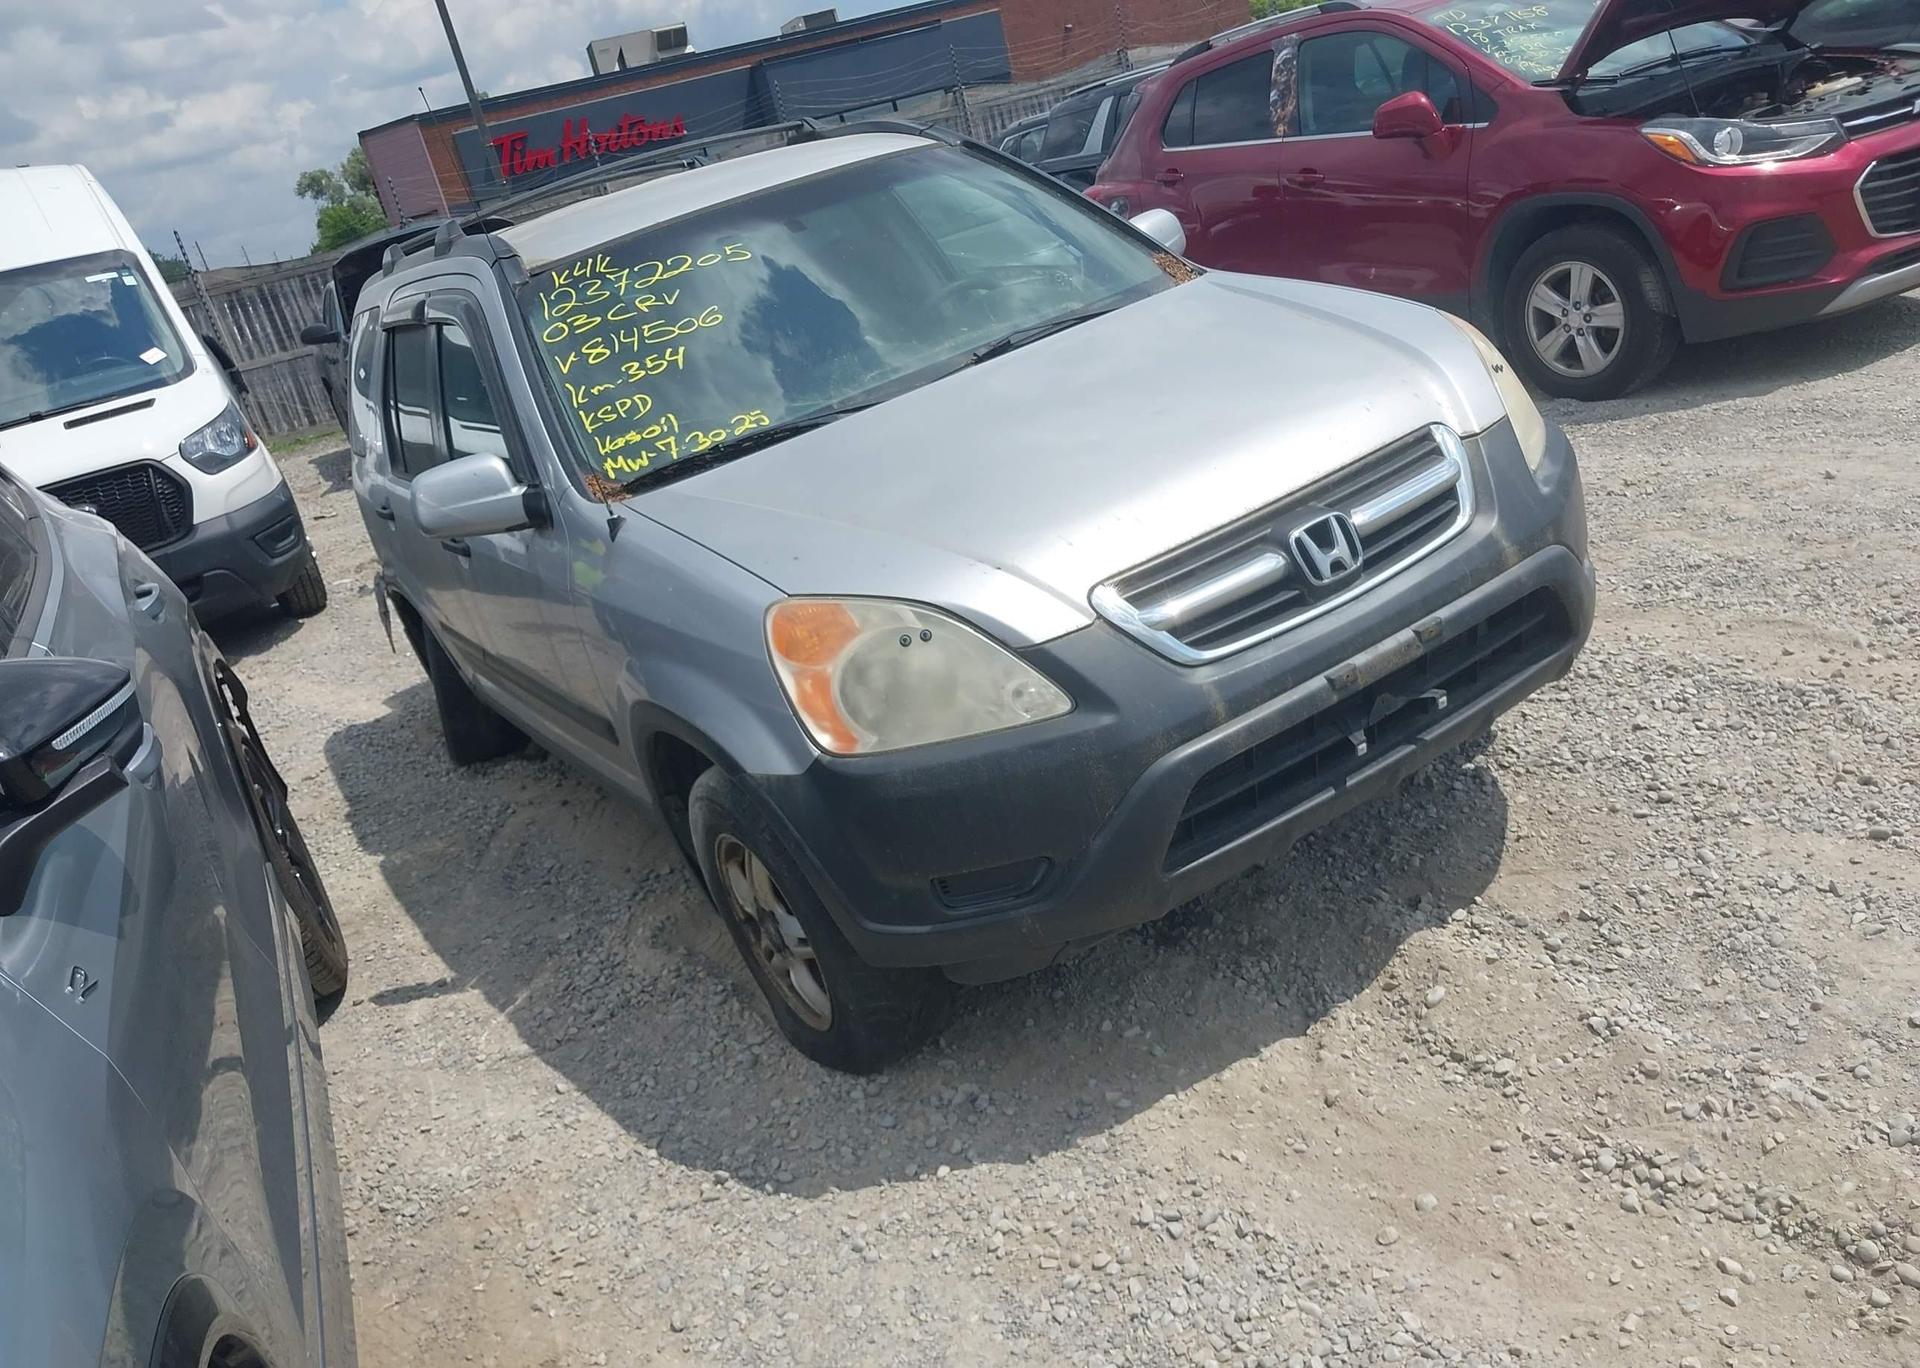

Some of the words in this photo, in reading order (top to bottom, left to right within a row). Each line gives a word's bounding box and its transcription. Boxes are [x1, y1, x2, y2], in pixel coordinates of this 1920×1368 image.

[1493, 22, 1537, 37] TRAX
[492, 131, 556, 177] Tim
[561, 112, 687, 163] Hortons
[539, 243, 752, 320] 12372205
[607, 289, 680, 323] CRV
[579, 394, 652, 433] KSPD
